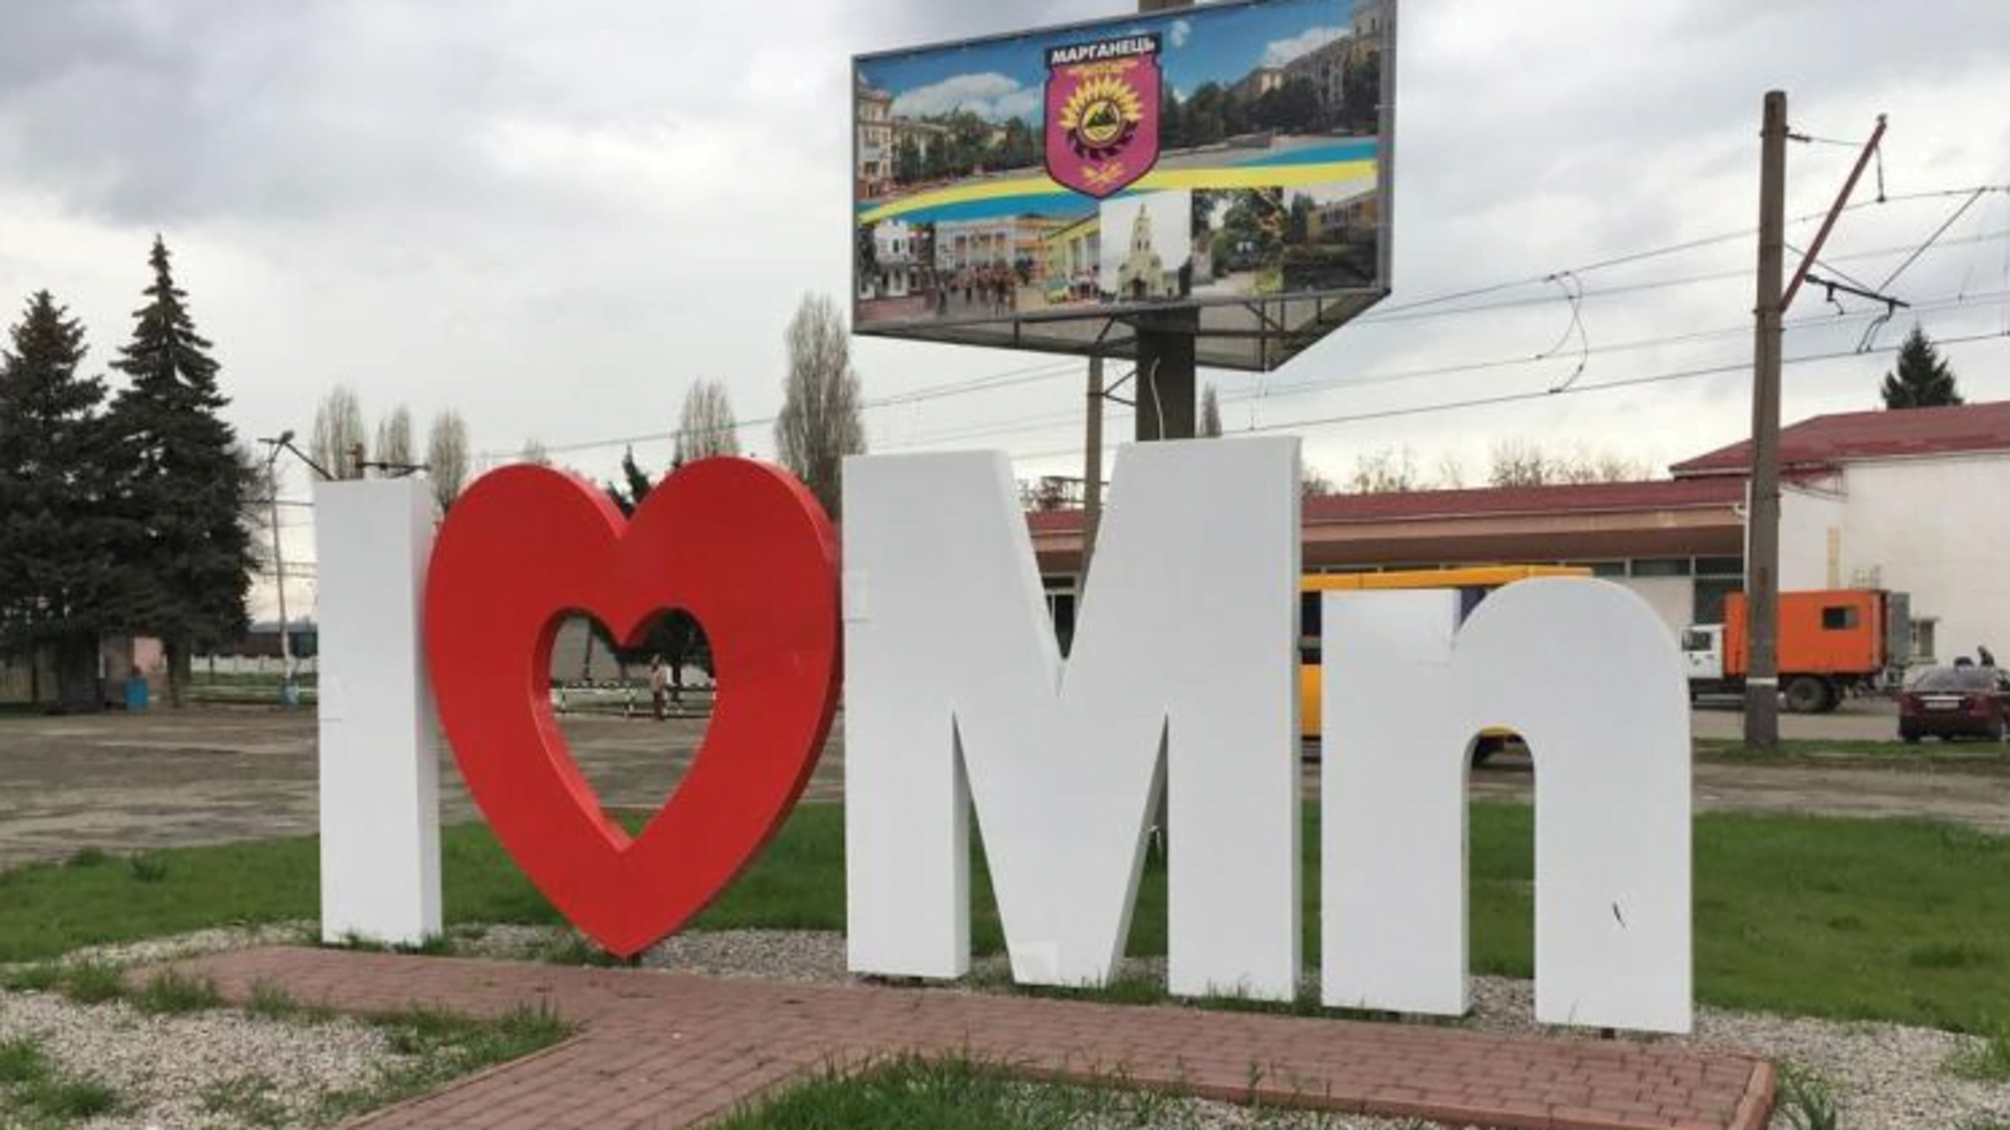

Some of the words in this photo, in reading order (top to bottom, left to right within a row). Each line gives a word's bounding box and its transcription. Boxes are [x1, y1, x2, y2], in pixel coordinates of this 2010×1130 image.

[1051, 37, 1156, 64] МАРГАНЕЦЬ
[314, 478, 442, 947] I
[841, 435, 1695, 1034] Mn
